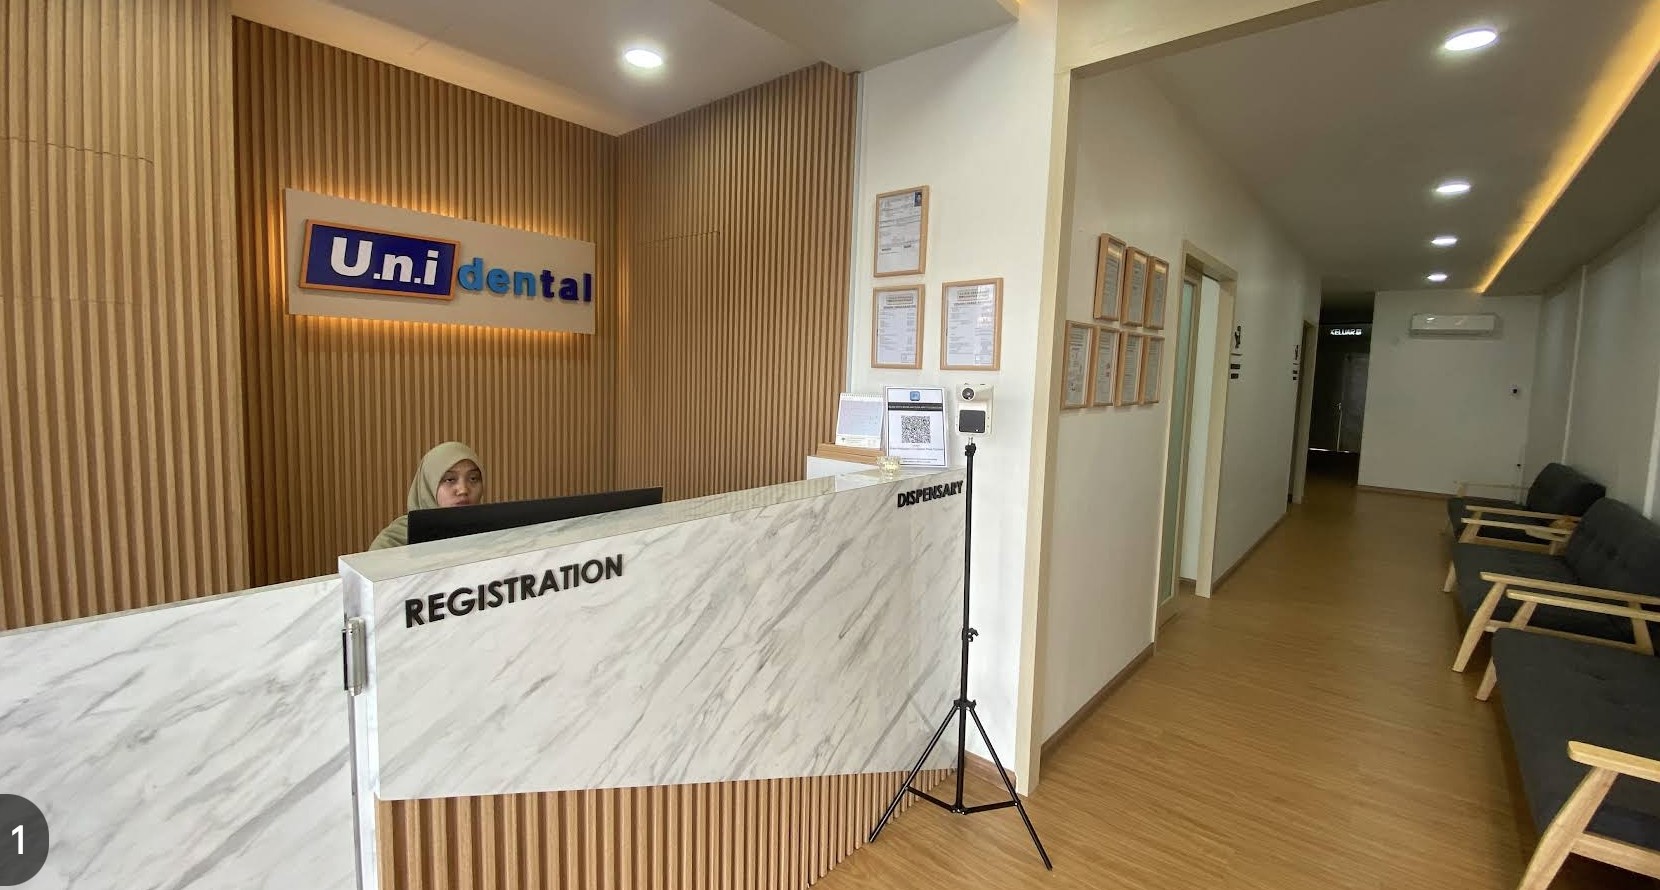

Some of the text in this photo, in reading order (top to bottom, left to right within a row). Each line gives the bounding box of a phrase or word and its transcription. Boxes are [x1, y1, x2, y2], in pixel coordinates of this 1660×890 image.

[330, 237, 592, 302] U.n.i dental
[897, 480, 963, 508] DISPENSARY
[405, 554, 623, 629] REGISTRATION
